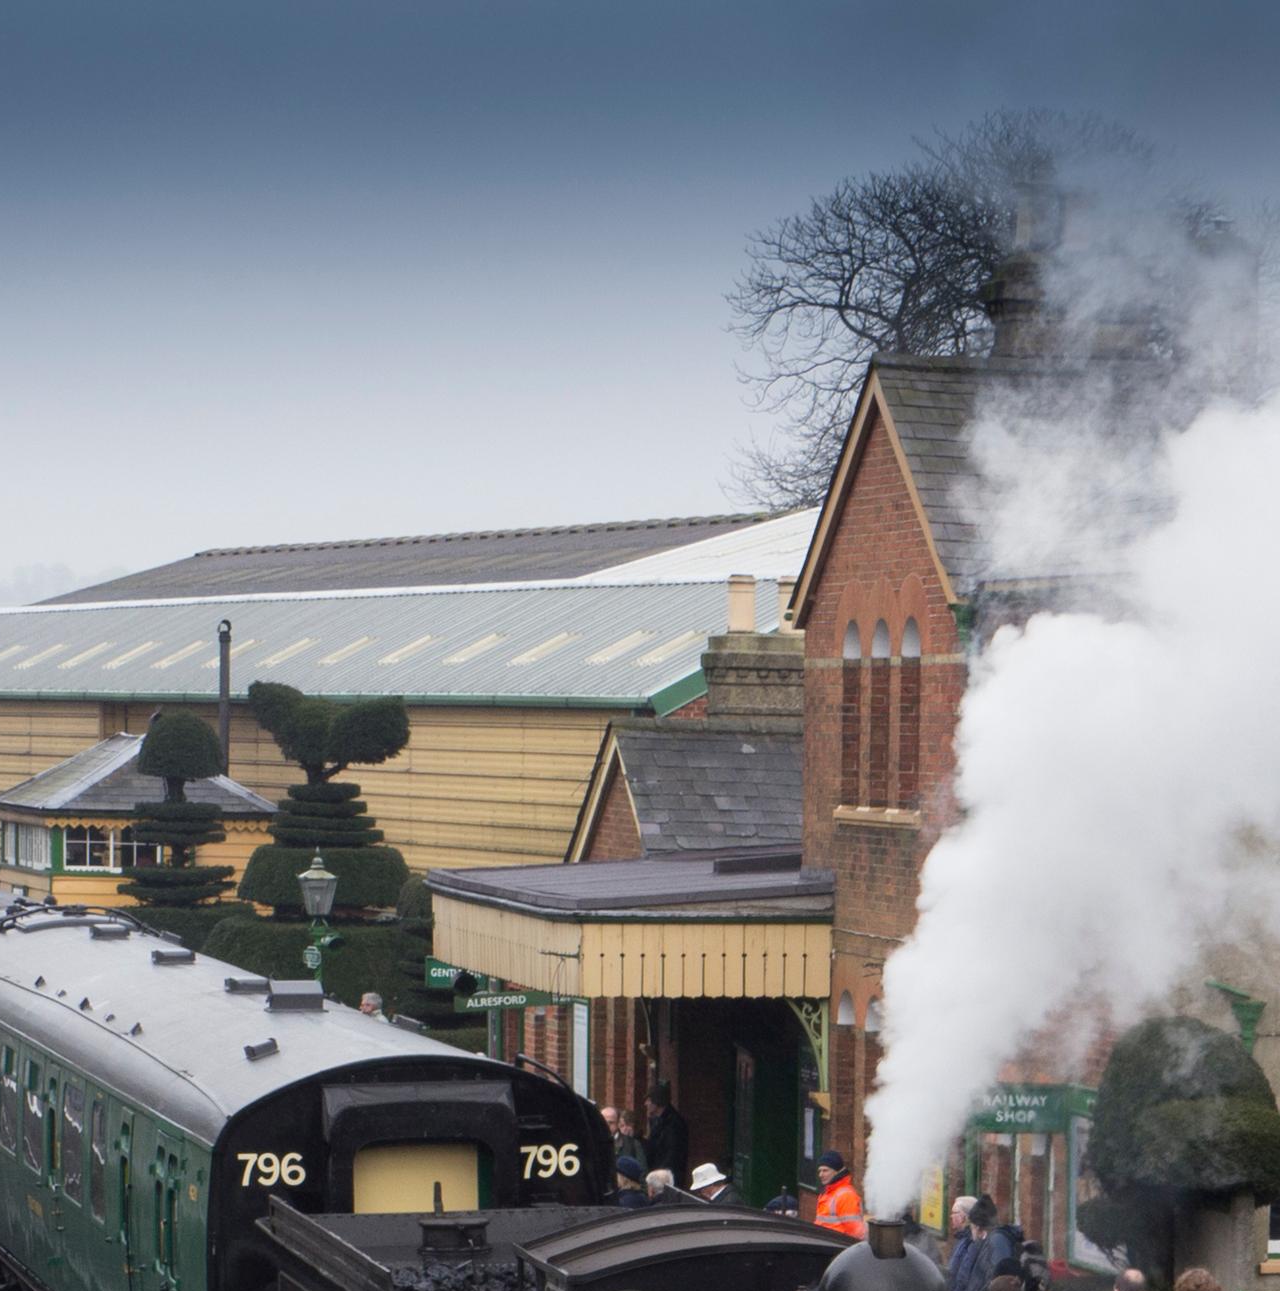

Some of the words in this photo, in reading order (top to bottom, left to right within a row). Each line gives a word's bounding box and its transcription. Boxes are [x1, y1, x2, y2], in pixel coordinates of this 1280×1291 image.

[466, 995, 526, 1008] ALRESFORD
[983, 1095, 1047, 1107] RAILWAY
[995, 1110, 1037, 1124] SHOP
[520, 1143, 580, 1179] 796
[237, 1152, 306, 1187] 796
